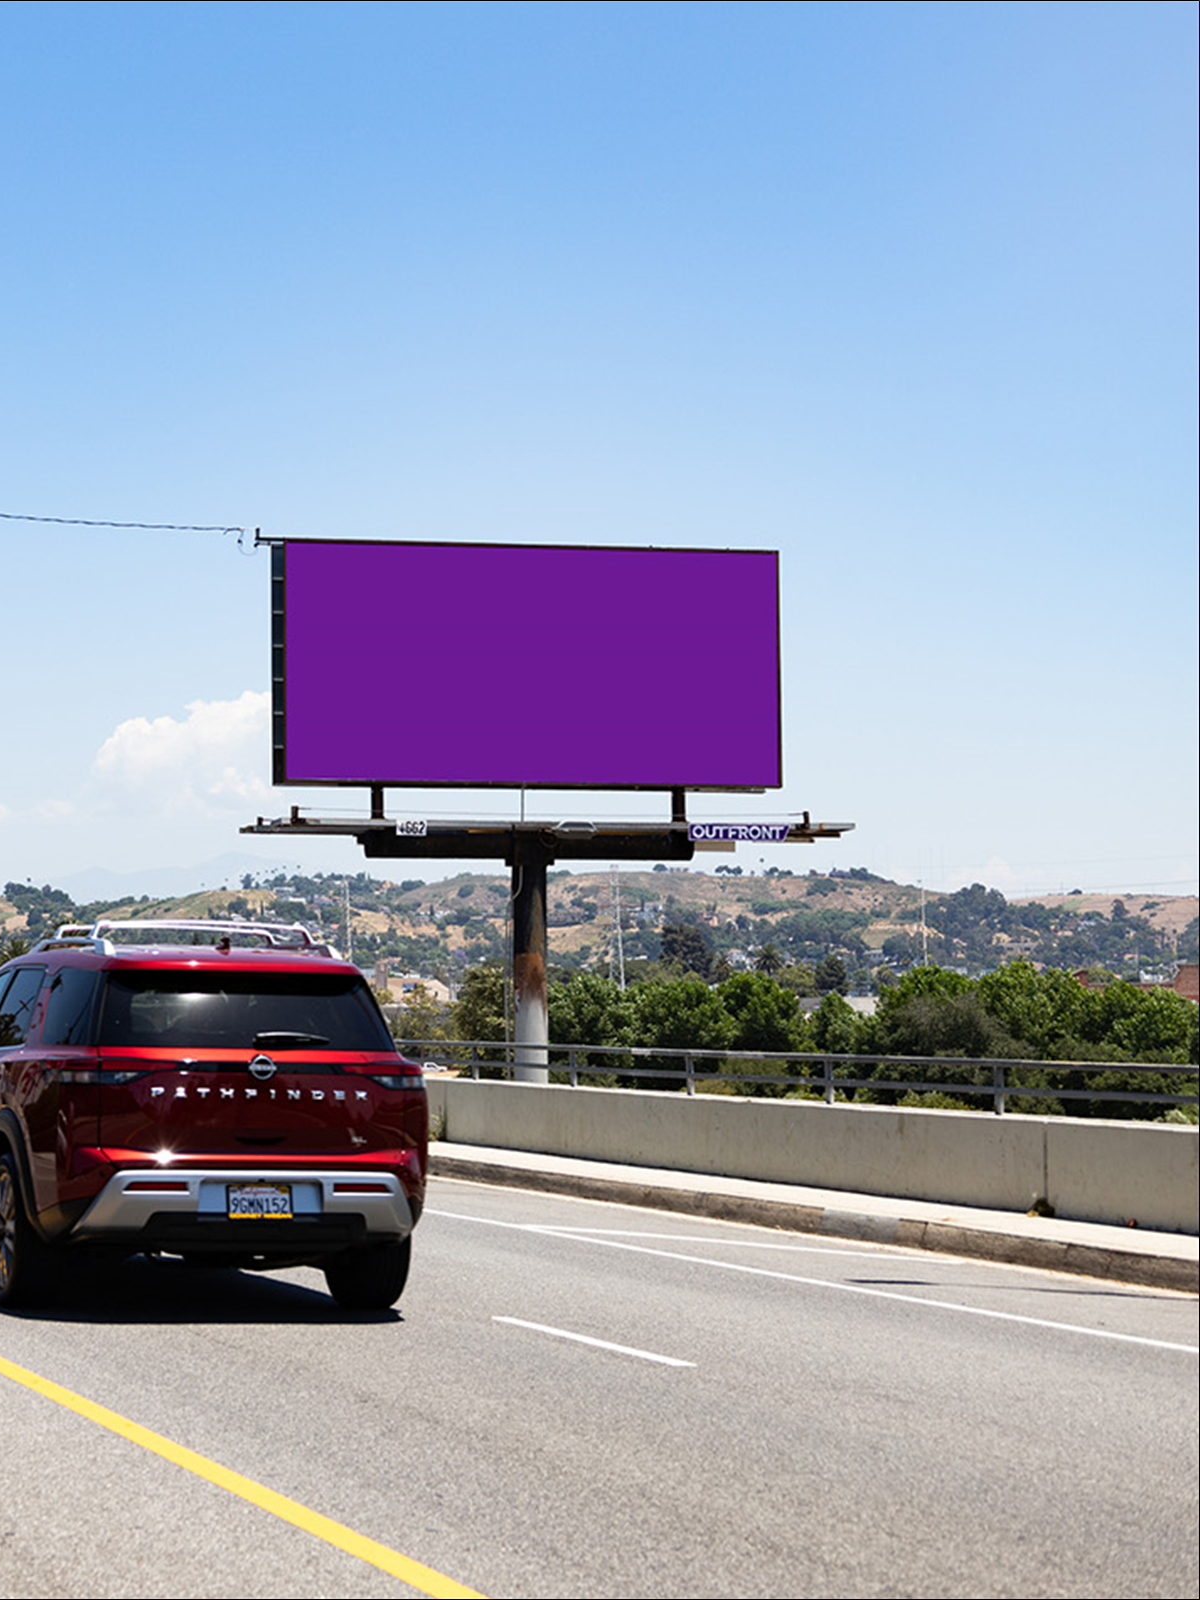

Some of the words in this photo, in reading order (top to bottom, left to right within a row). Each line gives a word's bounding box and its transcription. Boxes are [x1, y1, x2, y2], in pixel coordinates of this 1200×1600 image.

[692, 825, 785, 839] OUTFRONT
[150, 1086, 368, 1100] PATHFINDER
[231, 1197, 288, 1213] 9GMN152
